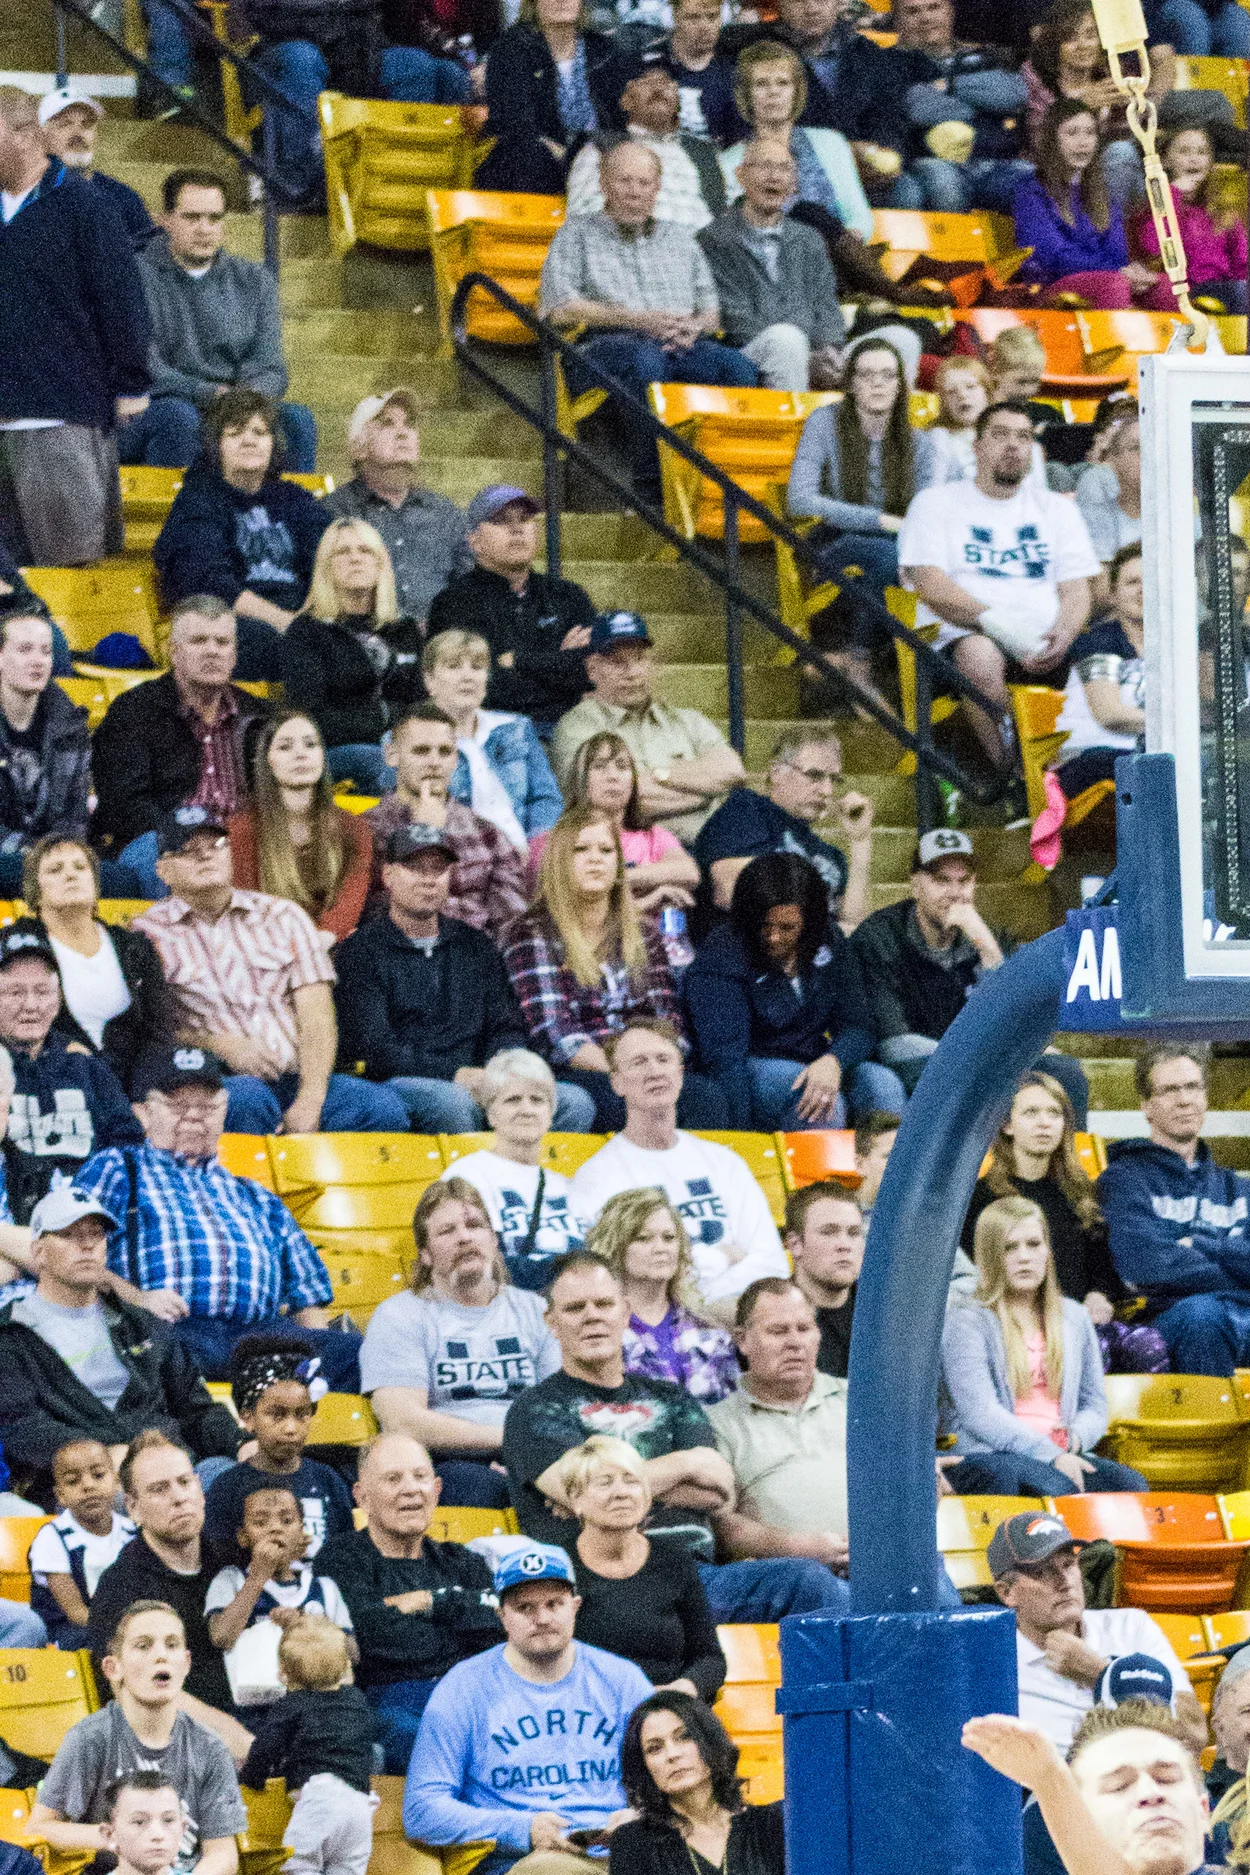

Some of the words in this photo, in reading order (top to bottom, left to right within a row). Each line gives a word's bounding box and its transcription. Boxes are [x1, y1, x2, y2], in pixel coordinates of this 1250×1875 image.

[436, 1356, 535, 1387] STATE
[491, 1708, 619, 1755] NORTH
[490, 1757, 623, 1791] CAROLINA
